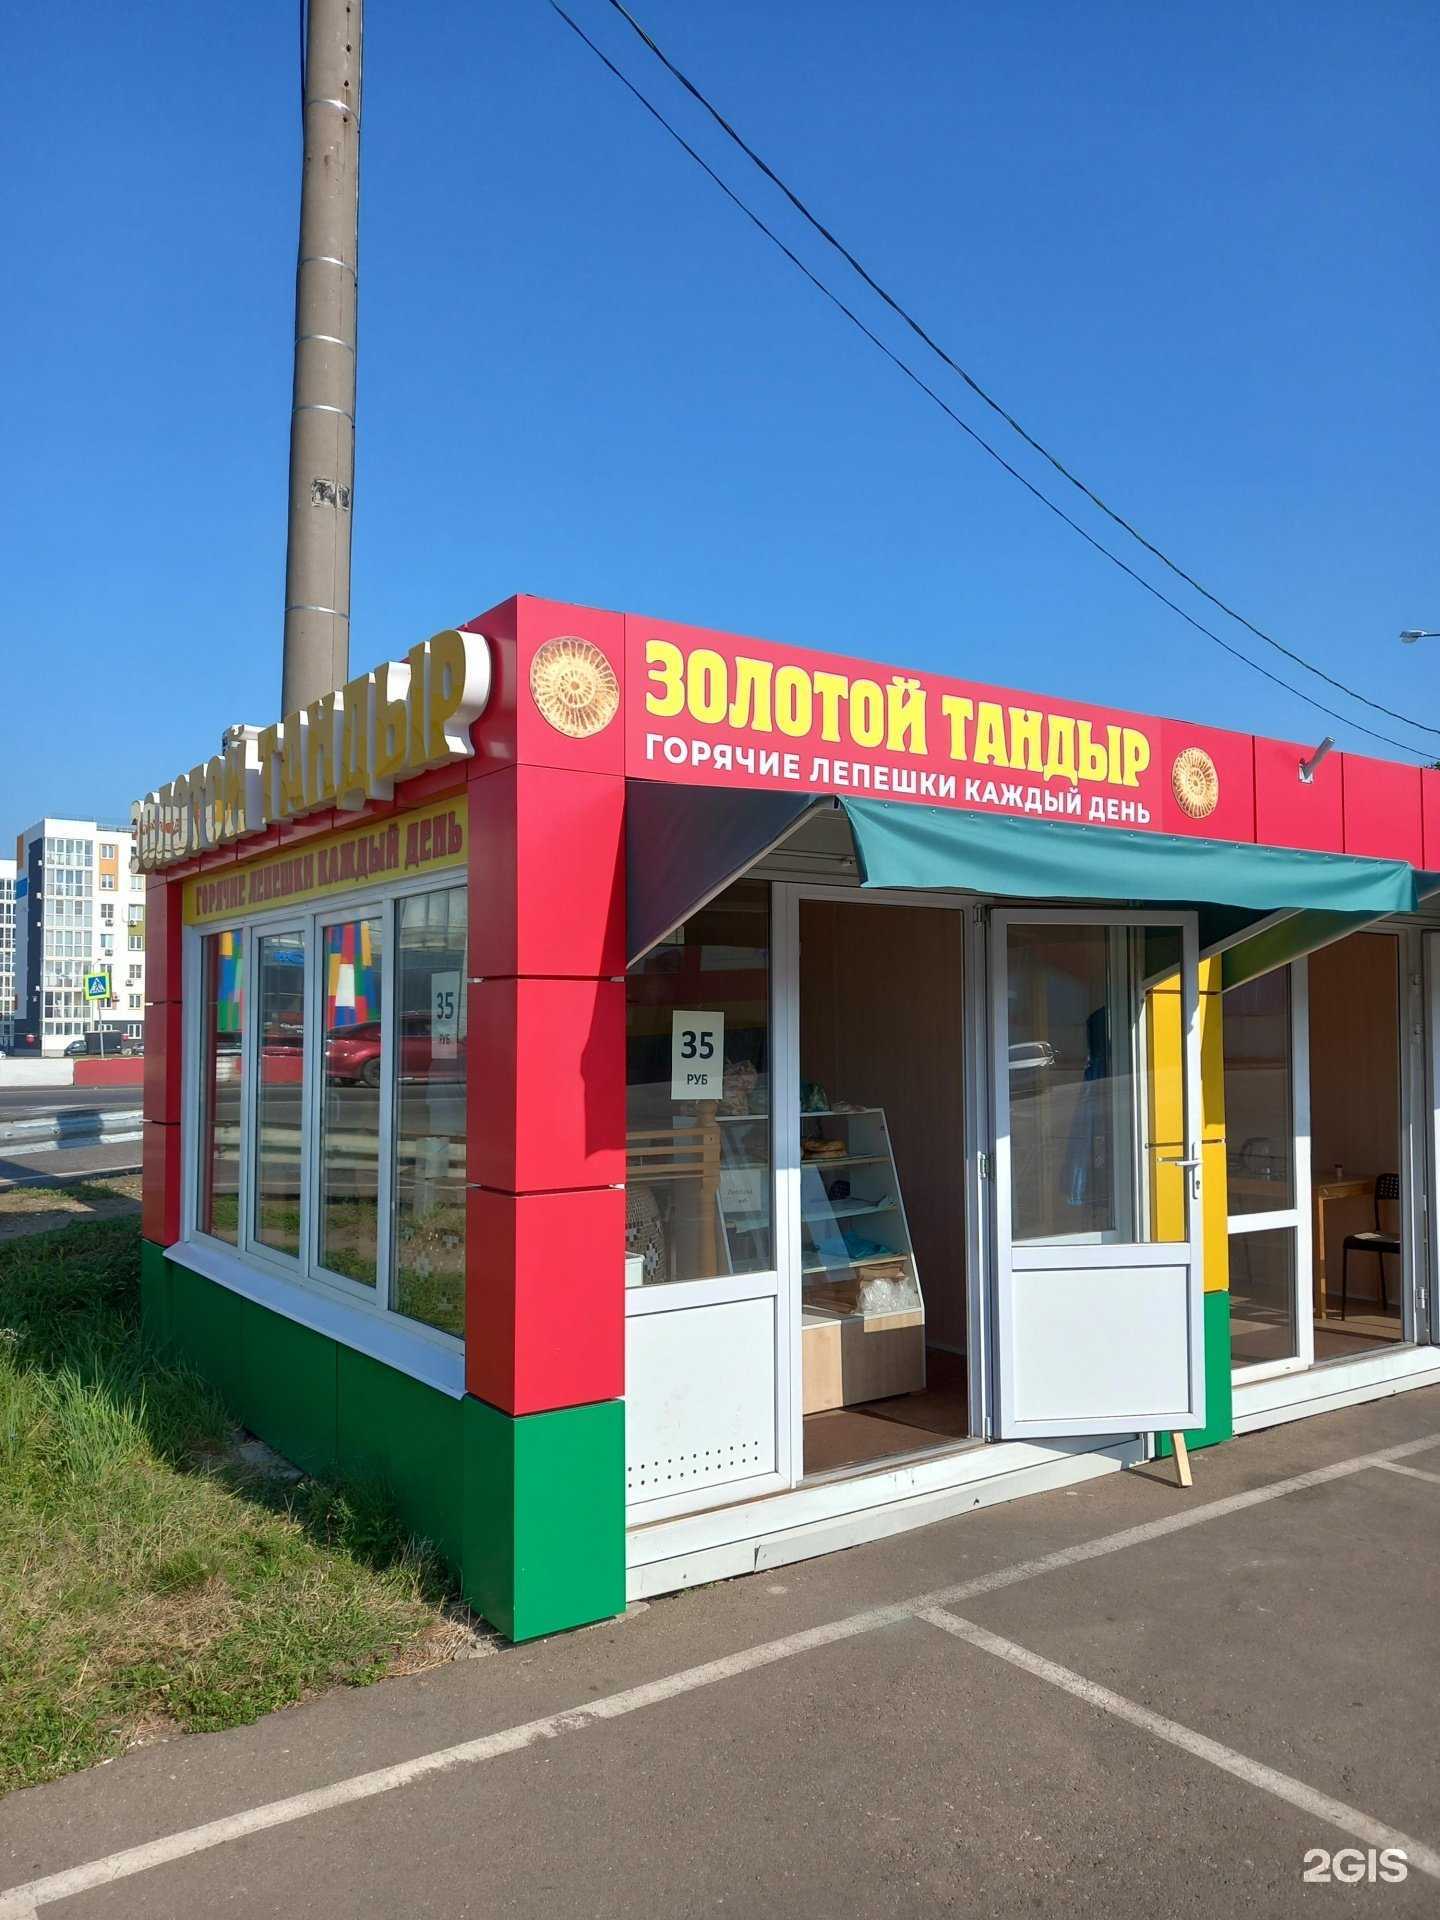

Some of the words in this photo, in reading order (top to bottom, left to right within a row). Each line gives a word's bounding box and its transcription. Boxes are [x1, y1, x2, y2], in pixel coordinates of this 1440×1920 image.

[257, 629, 491, 824] ТАНДЫР
[645, 639, 928, 755] ЗОЛОТОЙ
[942, 694, 1151, 787] ТАНДЫР
[646, 733, 800, 780] ГОРЯЧИЕ
[809, 757, 956, 799] ЛЕПЕШКИ
[965, 777, 1082, 816] КАЖДЫЙ
[1089, 796, 1151, 824] ДЕНЬ
[195, 874, 246, 916] ГОРЯЧИЕ
[249, 853, 315, 904] ЛЕПЕШКИ
[318, 823, 400, 886] КАЖДЫЙ
[405, 811, 464, 870] ДЕНЬ
[436, 992, 454, 1020] 35
[681, 1030, 714, 1060] 35
[686, 1073, 708, 1086] РУБ
